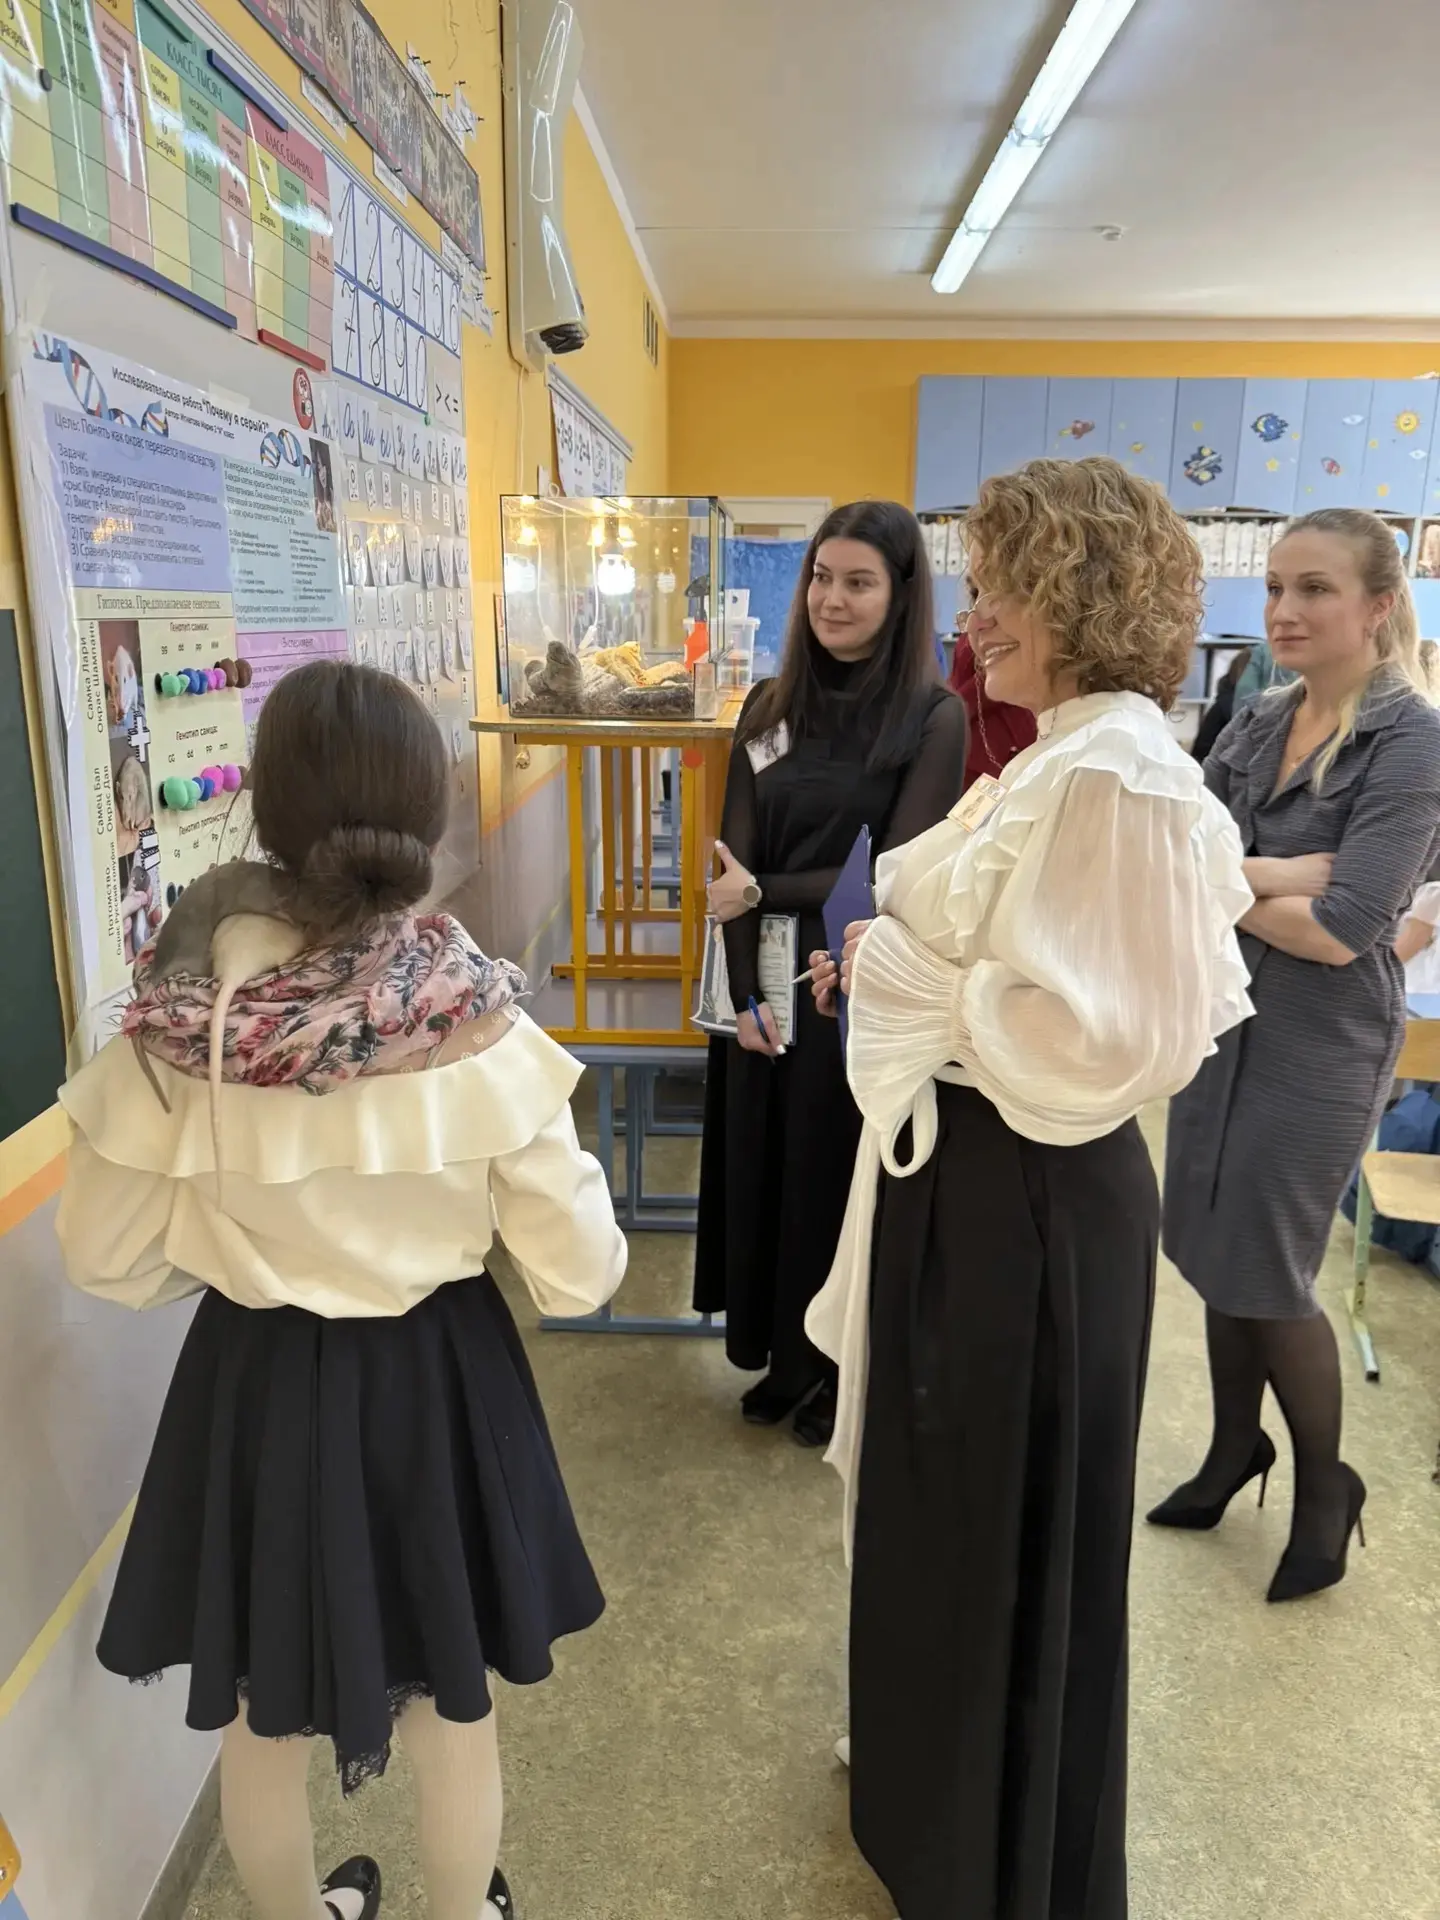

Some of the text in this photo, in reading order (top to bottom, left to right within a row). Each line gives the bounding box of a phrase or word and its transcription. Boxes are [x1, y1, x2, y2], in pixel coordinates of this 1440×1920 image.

[166, 39, 194, 79] КЛАСС
[195, 66, 224, 103] ТЫСЯЧ
[265, 129, 314, 182] КЛАСС ЕДИНИЦ
[339, 183, 354, 265] 1
[366, 201, 380, 293] 2
[391, 225, 404, 309] 3
[412, 245, 424, 330] 4
[432, 263, 442, 339] 5
[450, 282, 460, 352] 6
[341, 279, 356, 372] 7
[370, 301, 384, 387] 8
[393, 316, 405, 397] 9
[415, 335, 426, 408] 0
[112, 366, 181, 403] Исследовательская
[182, 395, 203, 412] работа
[202, 398, 234, 426] "Почему
[234, 414, 240, 425] я
[53, 411, 80, 434] Цель:
[80, 418, 110, 440] Понять
[111, 429, 124, 442] как
[124, 433, 144, 449] окрас
[343, 402, 355, 439] Оо
[57, 443, 88, 463] Задачи:
[69, 463, 89, 477] Взять
[62, 478, 82, 492] крыс
[97, 594, 135, 610] Гипотеза.
[170, 622, 190, 632] Генотип
[80, 637, 94, 720] Самка Лари
[89, 621, 104, 734] Окрас Шампань
[176, 728, 199, 740] Генотип
[96, 792, 105, 836] Самец
[105, 792, 114, 833] Окрас
[179, 821, 200, 837] Генотип
[105, 867, 114, 937] Потомство
[113, 884, 121, 926] Русский
[115, 927, 123, 956] Окрас
